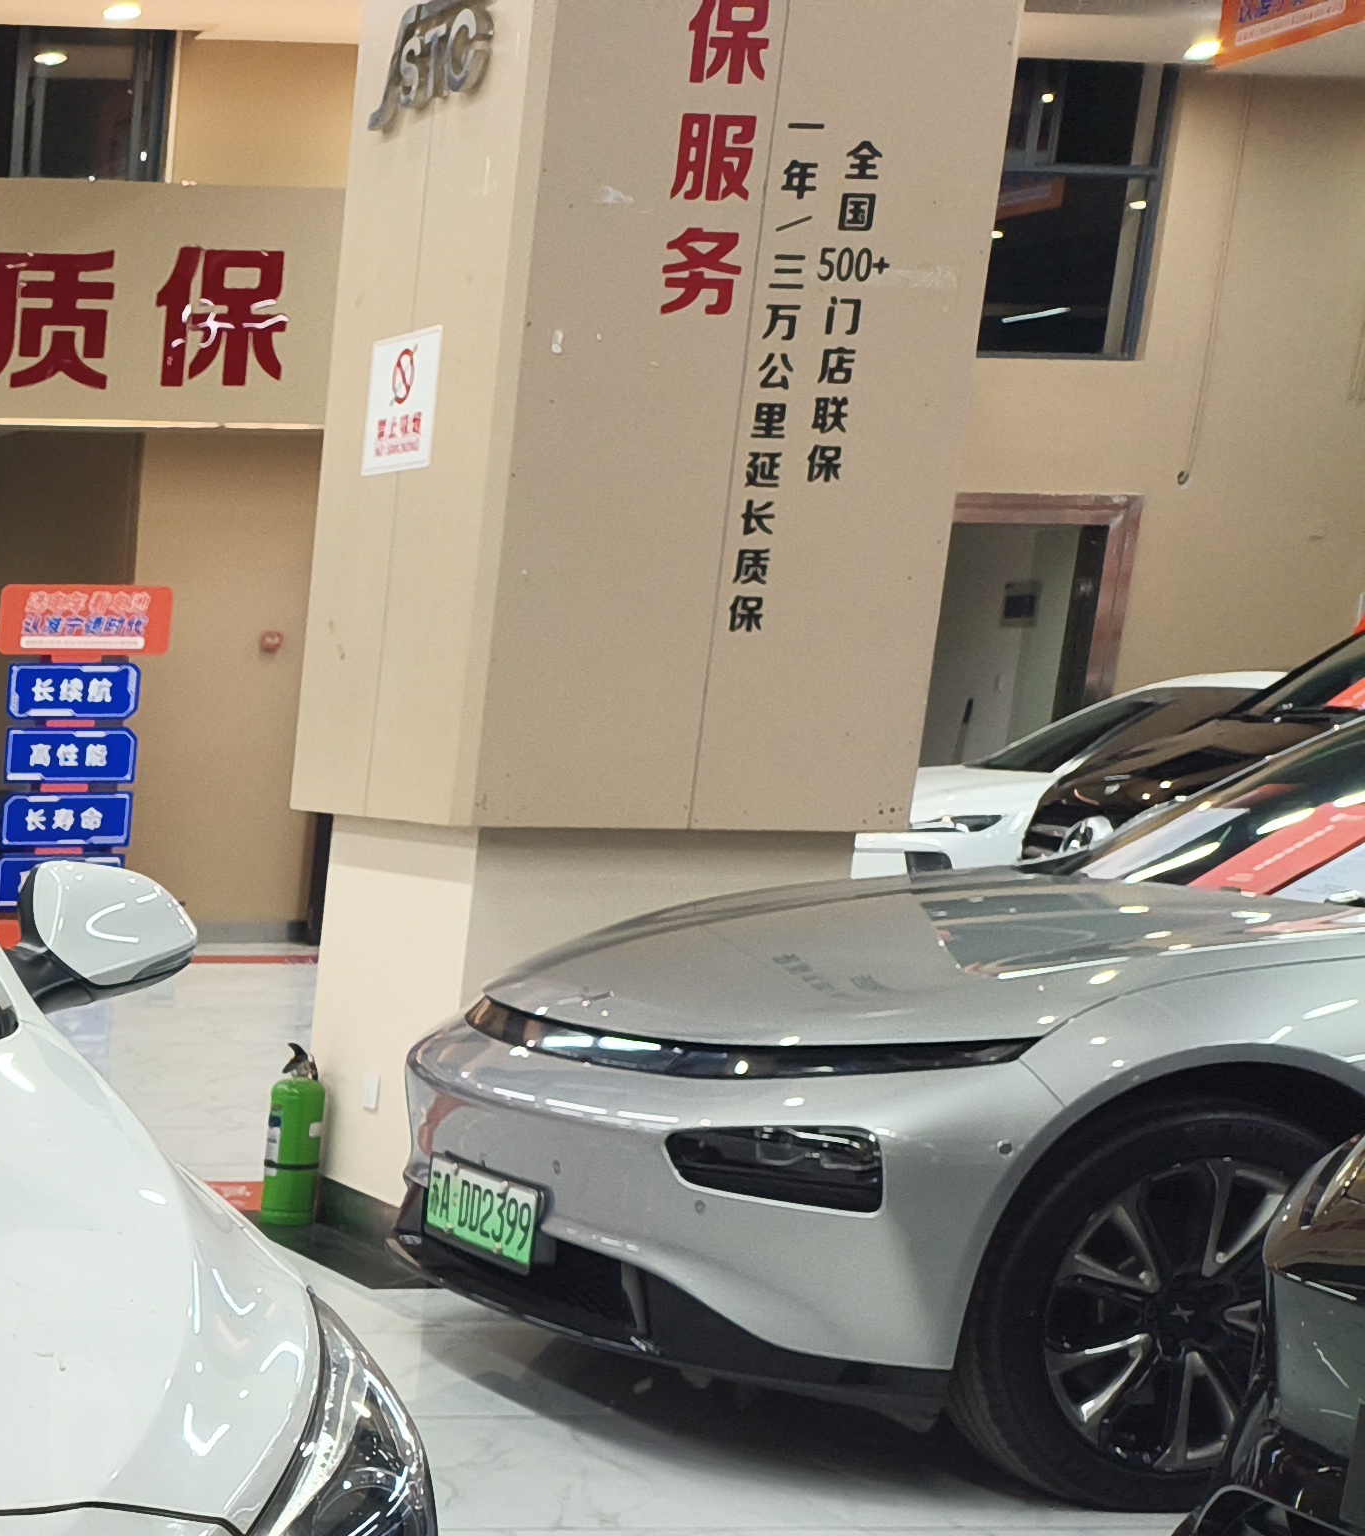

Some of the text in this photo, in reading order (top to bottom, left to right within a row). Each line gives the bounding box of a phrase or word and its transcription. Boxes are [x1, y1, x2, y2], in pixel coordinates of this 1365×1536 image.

[31, 677, 113, 703] 长续航
[29, 743, 108, 767] 高性能
[25, 807, 103, 832] 长寿命
